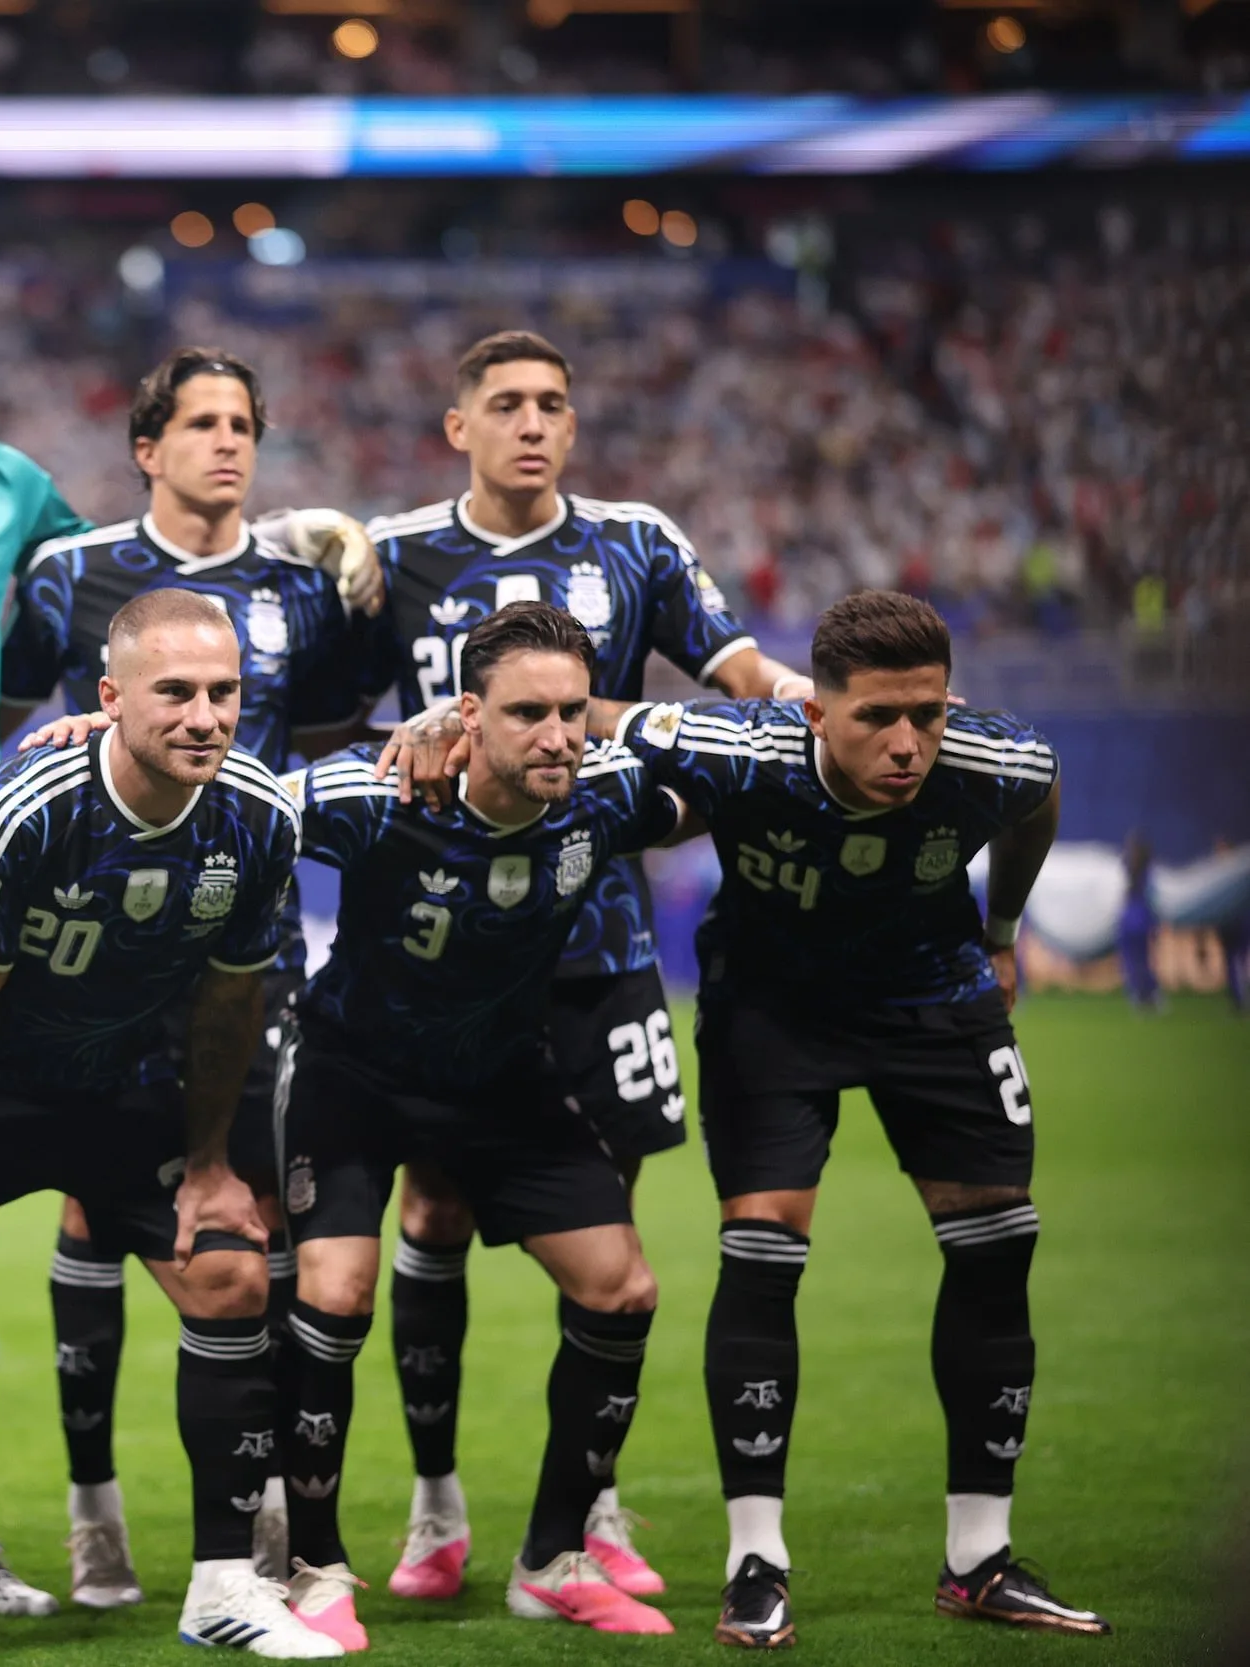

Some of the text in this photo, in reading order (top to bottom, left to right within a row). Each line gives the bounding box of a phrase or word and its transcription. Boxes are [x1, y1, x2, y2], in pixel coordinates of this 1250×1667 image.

[737, 842, 821, 910] 24
[19, 906, 103, 976] 20
[402, 901, 452, 961] 3
[608, 1009, 679, 1103] 26
